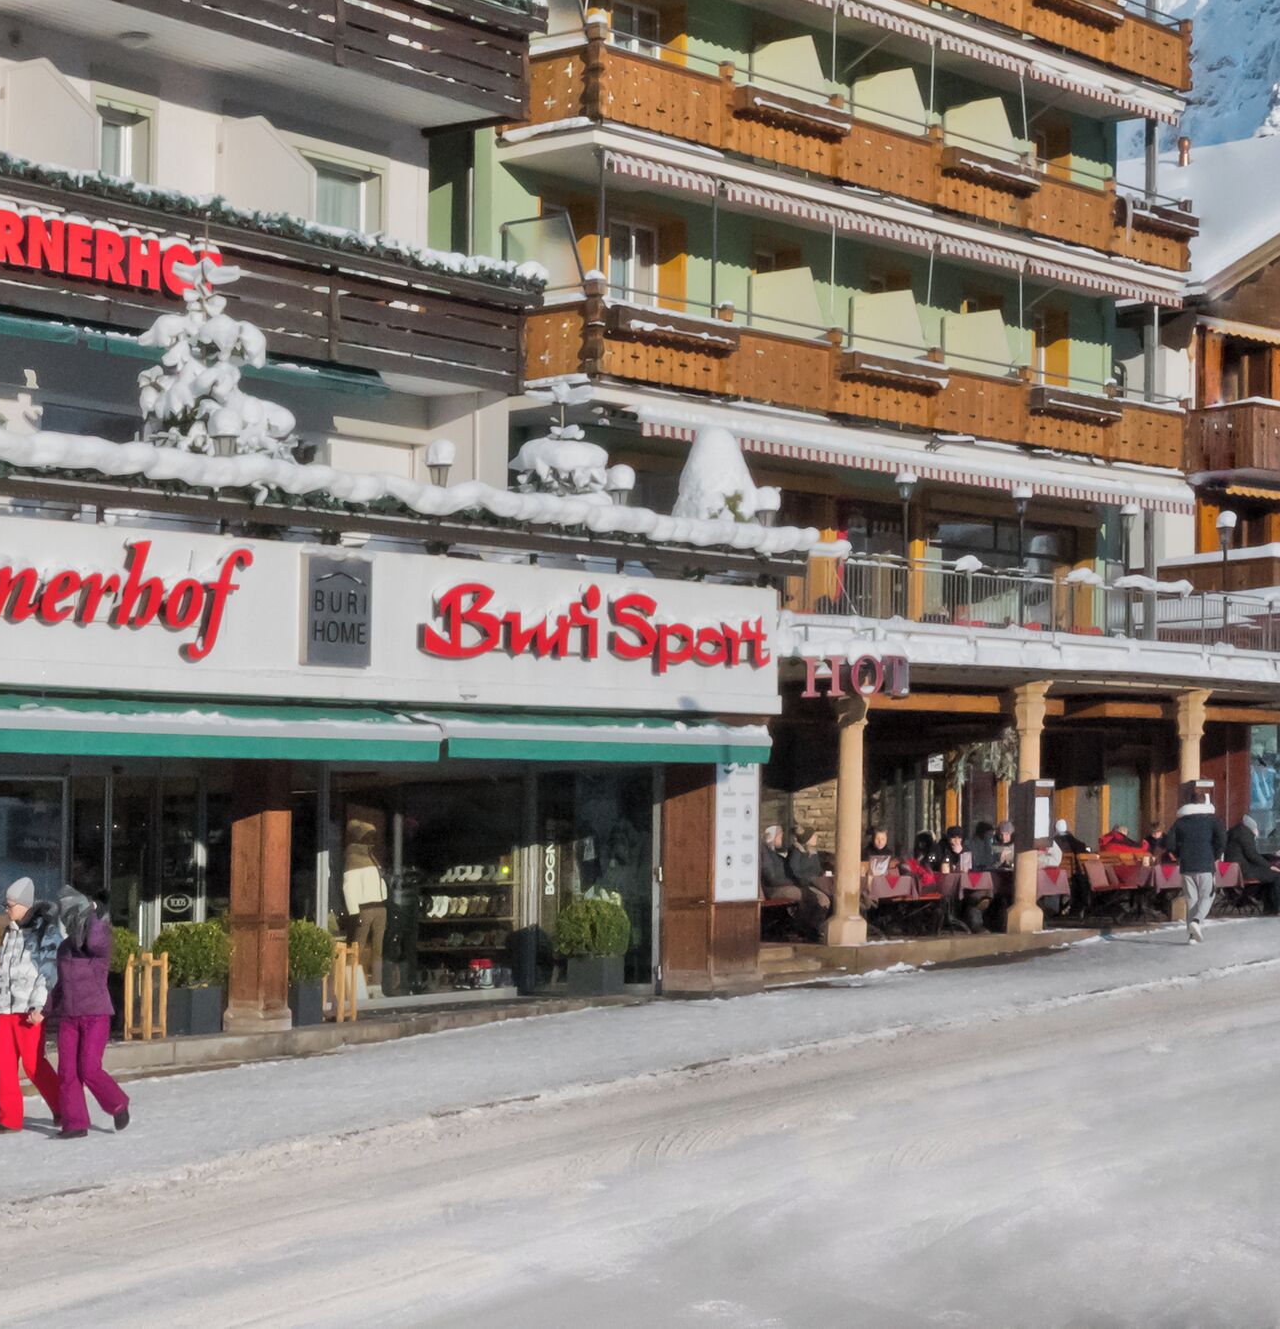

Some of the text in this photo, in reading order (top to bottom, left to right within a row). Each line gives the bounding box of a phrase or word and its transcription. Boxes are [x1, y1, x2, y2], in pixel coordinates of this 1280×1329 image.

[315, 589, 367, 615] BURI
[314, 620, 367, 645] HOME
[614, 594, 770, 673] Sport
